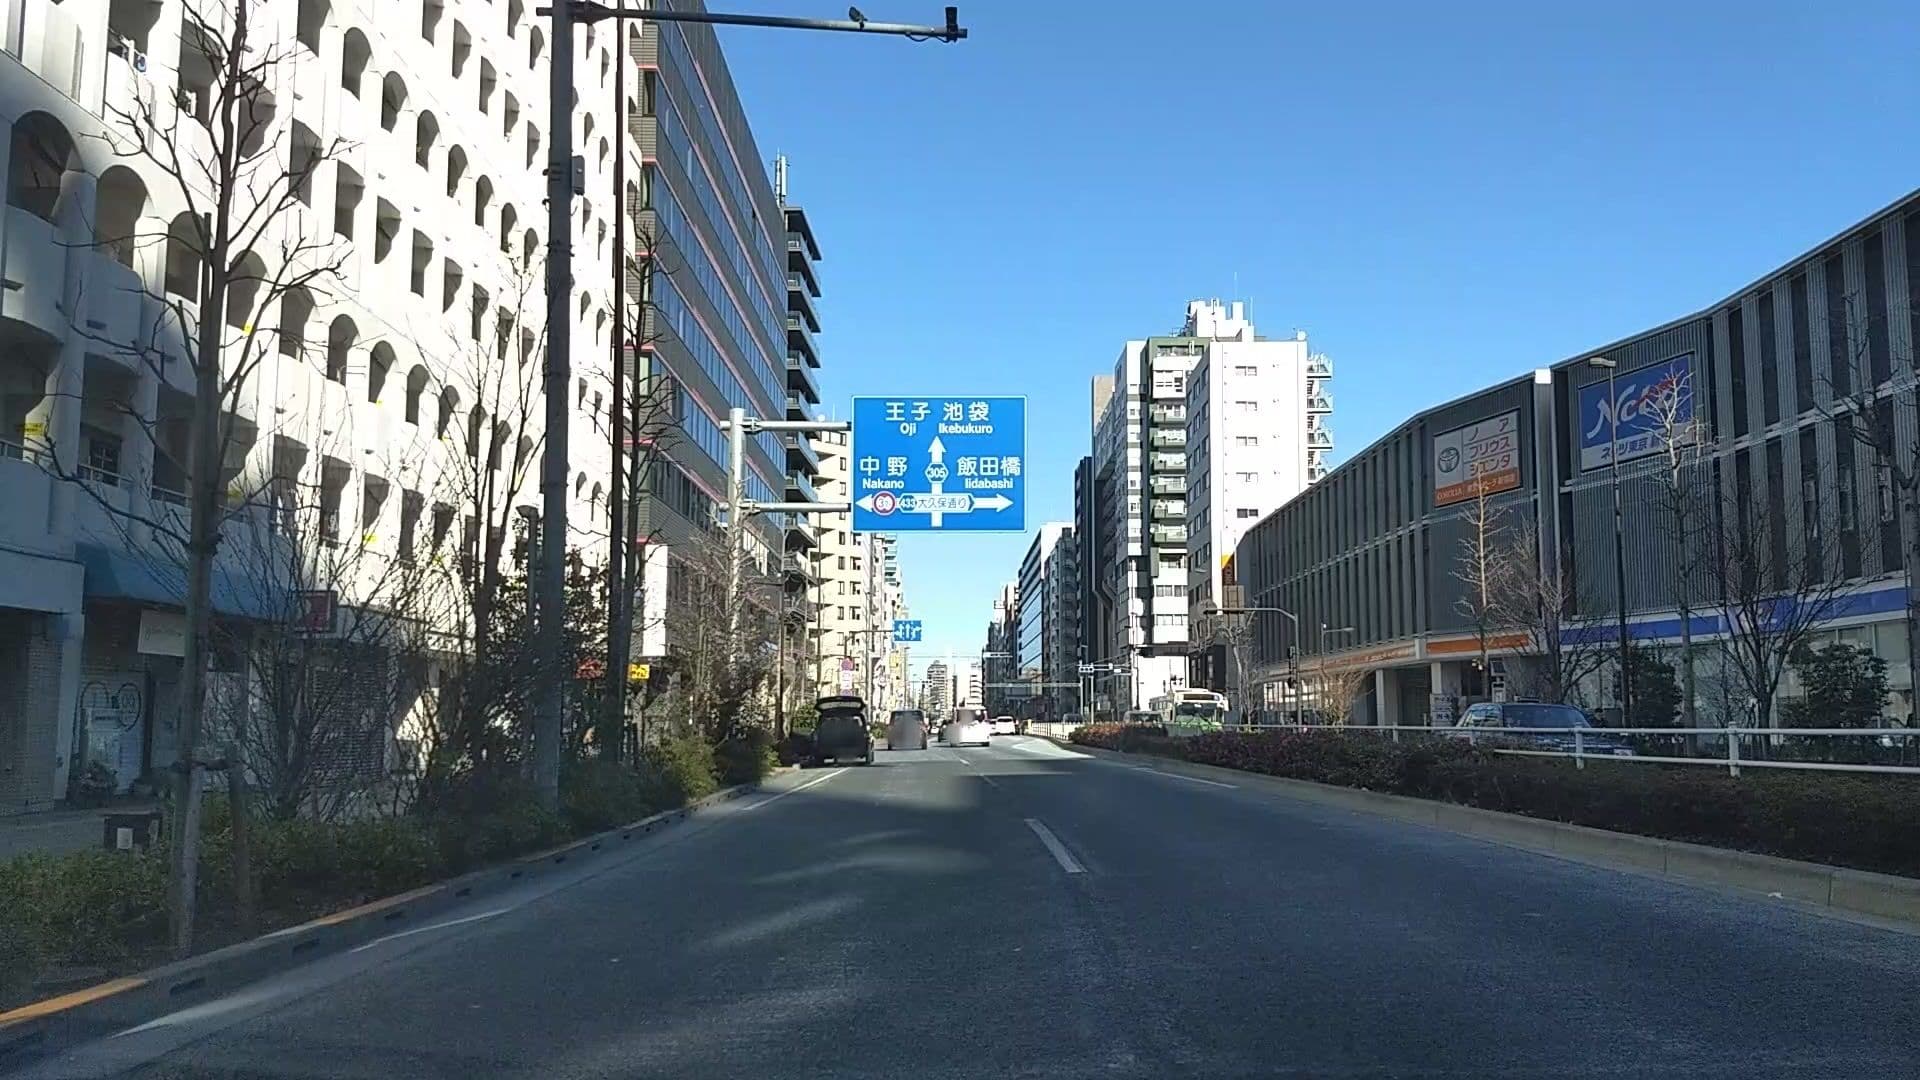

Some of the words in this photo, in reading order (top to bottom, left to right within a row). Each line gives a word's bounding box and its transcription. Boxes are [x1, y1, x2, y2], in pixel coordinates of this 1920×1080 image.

[885, 402, 931, 421] 王子
[943, 402, 989, 421] 池袋
[900, 423, 917, 436] Oji
[938, 423, 993, 434] Ikebukuro
[860, 456, 908, 477] 中野
[929, 467, 947, 478] 305
[957, 456, 1021, 477] 飯田橋
[863, 478, 905, 489] Nakano
[965, 478, 1014, 489] Iidabashi
[918, 497, 967, 508] 大久保通り
